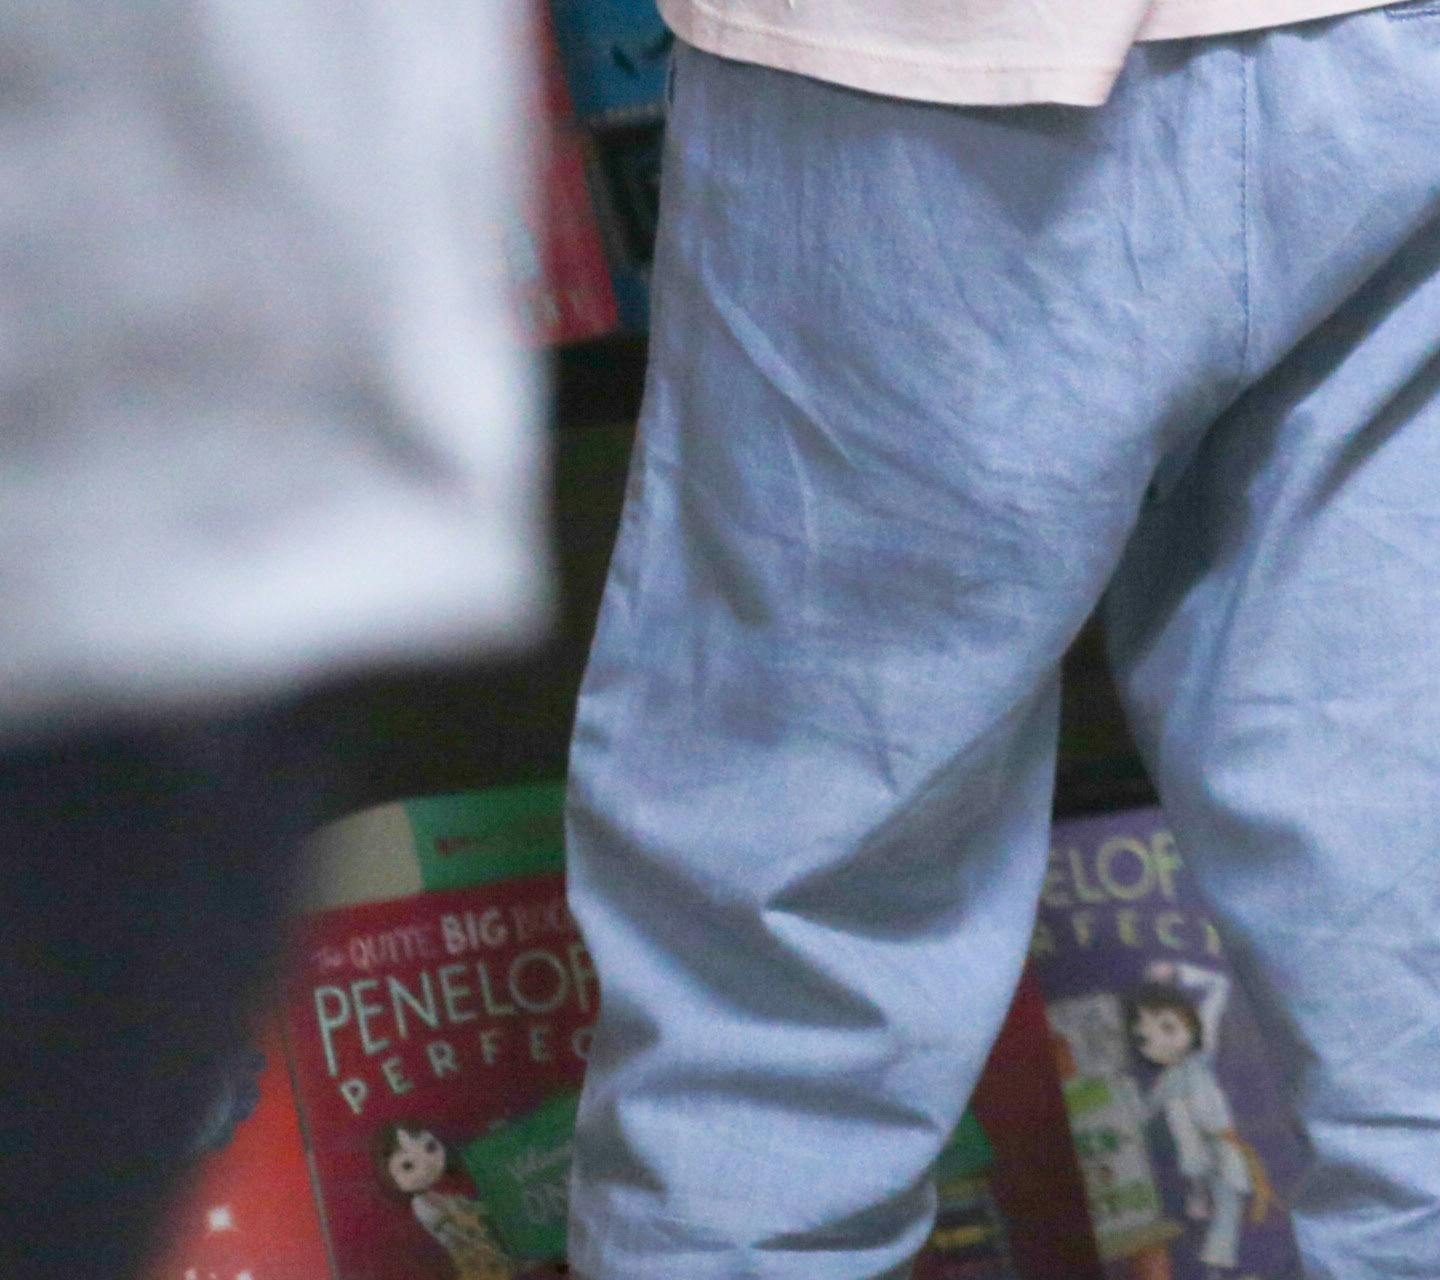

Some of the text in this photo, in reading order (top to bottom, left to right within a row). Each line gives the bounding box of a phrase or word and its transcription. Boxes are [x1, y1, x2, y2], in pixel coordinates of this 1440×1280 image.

[441, 907, 508, 955] BIG
[314, 945, 599, 1077] PENELOP
[340, 1025, 597, 1113] PERFEC
